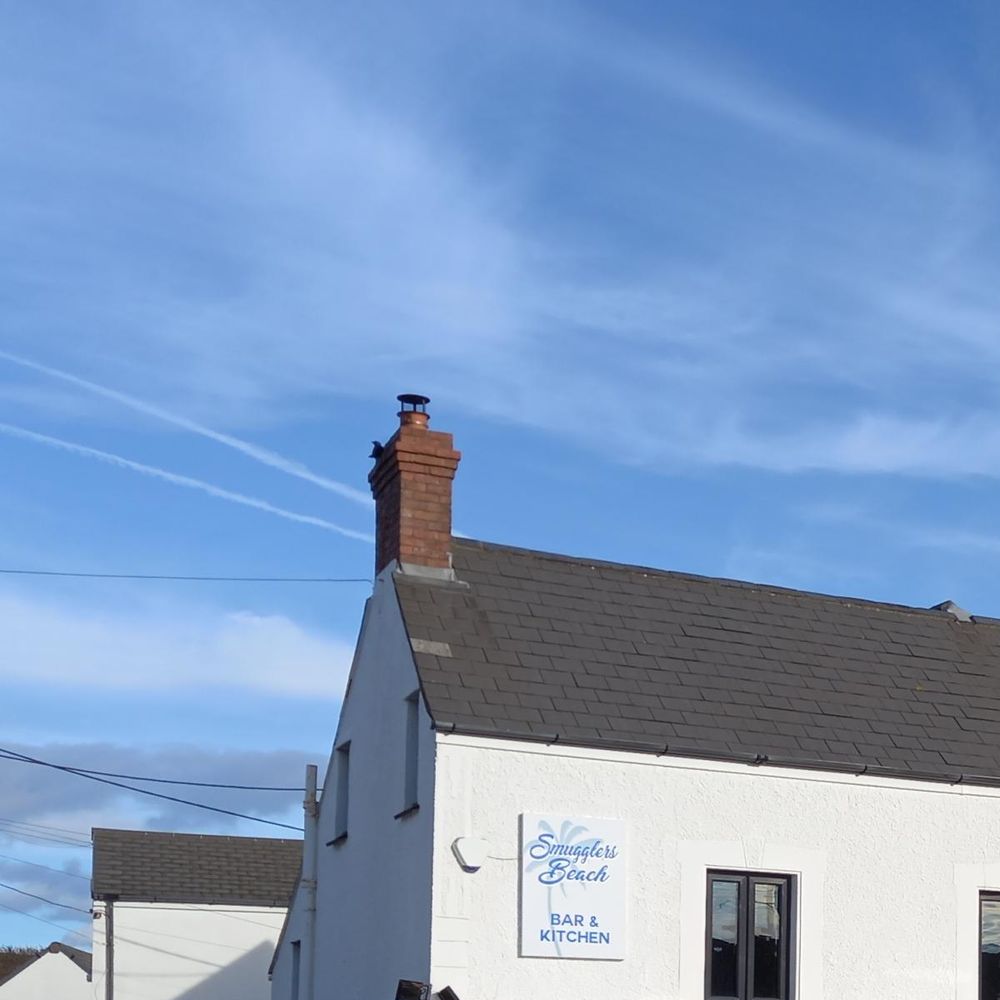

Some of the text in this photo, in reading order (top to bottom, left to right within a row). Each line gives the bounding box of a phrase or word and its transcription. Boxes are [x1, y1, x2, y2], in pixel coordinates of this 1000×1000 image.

[529, 834, 618, 864] Smugglers
[538, 858, 610, 885] Beach
[551, 913, 599, 927] BAR &
[540, 929, 610, 944] KITCHEN
